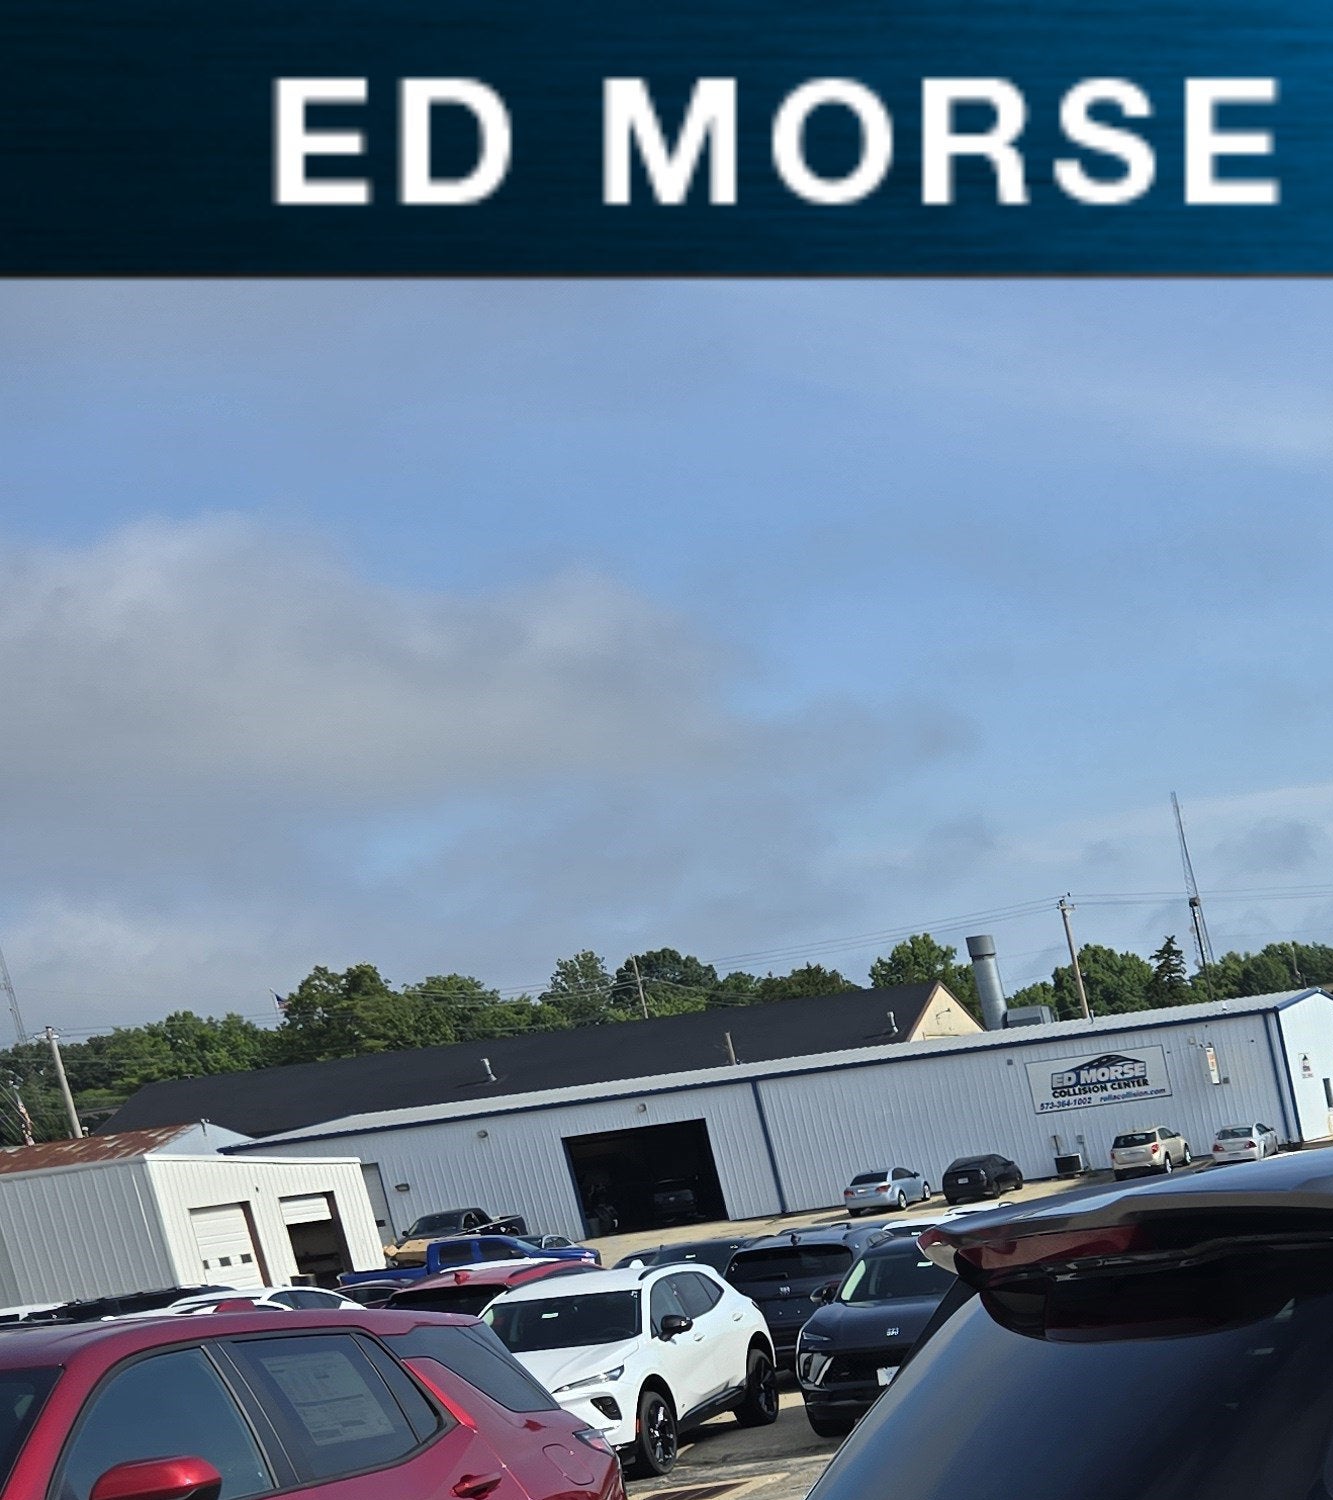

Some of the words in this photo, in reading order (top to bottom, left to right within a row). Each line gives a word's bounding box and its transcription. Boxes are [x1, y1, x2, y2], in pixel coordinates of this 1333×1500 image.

[1053, 1071, 1077, 1088] ED
[1080, 1062, 1146, 1085] MORSE
[1052, 1083, 1108, 1099] COLLISION
[1111, 1078, 1149, 1091] CENTER
[1040, 1097, 1093, 1111] 573-364-1002
